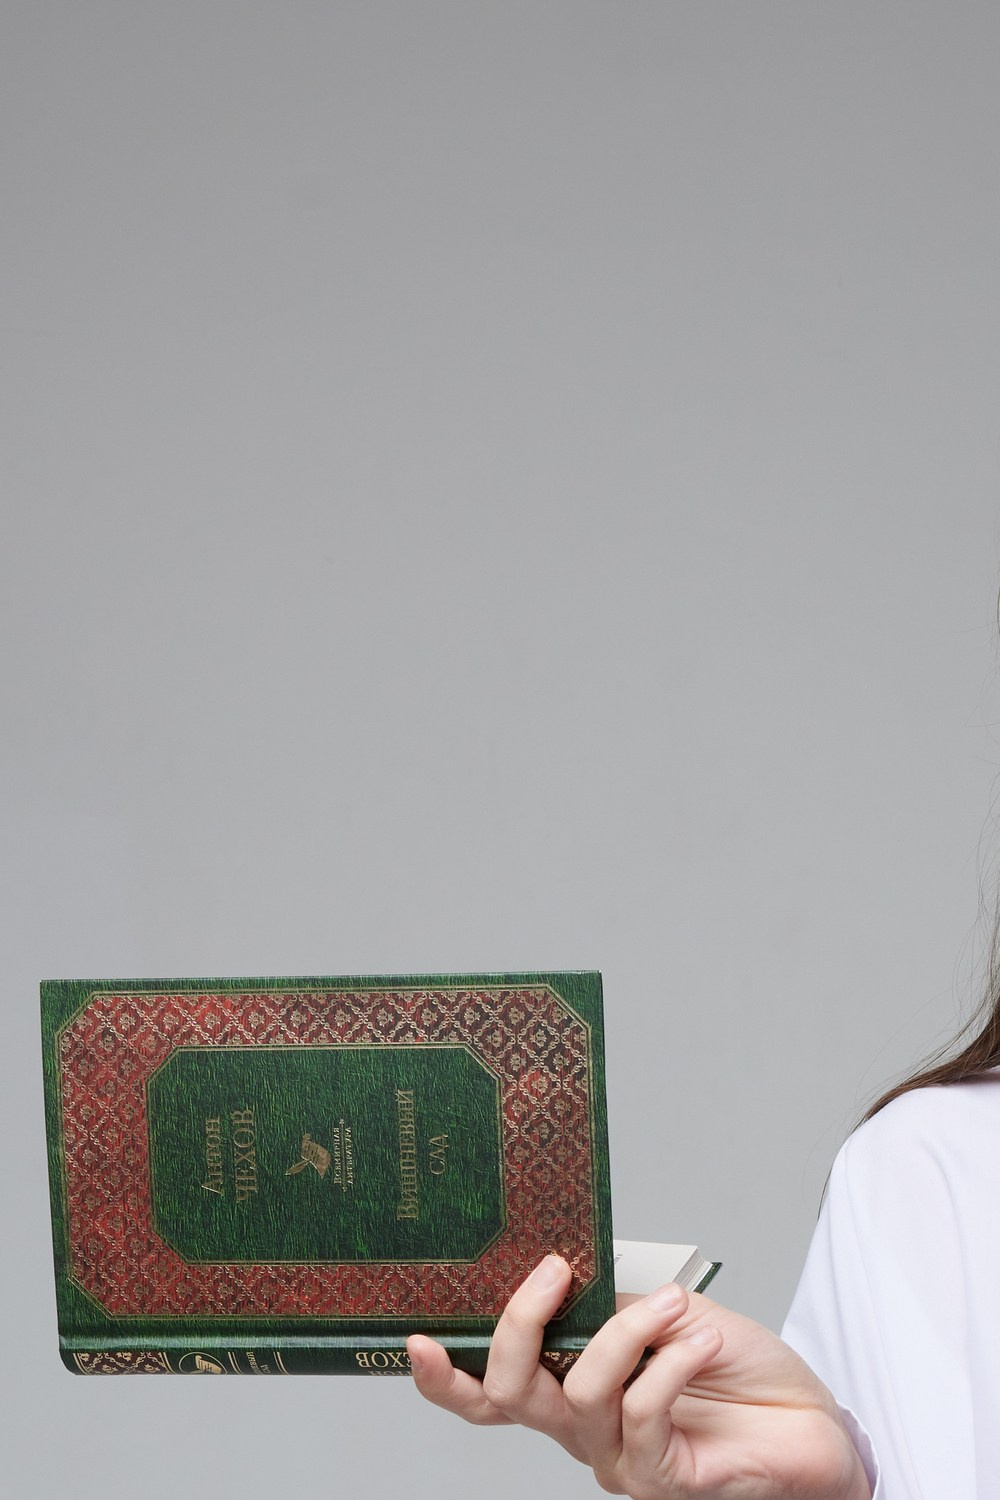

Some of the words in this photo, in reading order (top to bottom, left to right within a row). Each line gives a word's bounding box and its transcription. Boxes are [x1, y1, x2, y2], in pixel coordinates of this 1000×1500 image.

[231, 1109, 258, 1202] ЧЕХОВ
[429, 1134, 449, 1175] САД
[355, 1351, 412, 1368] ЕХОВ
